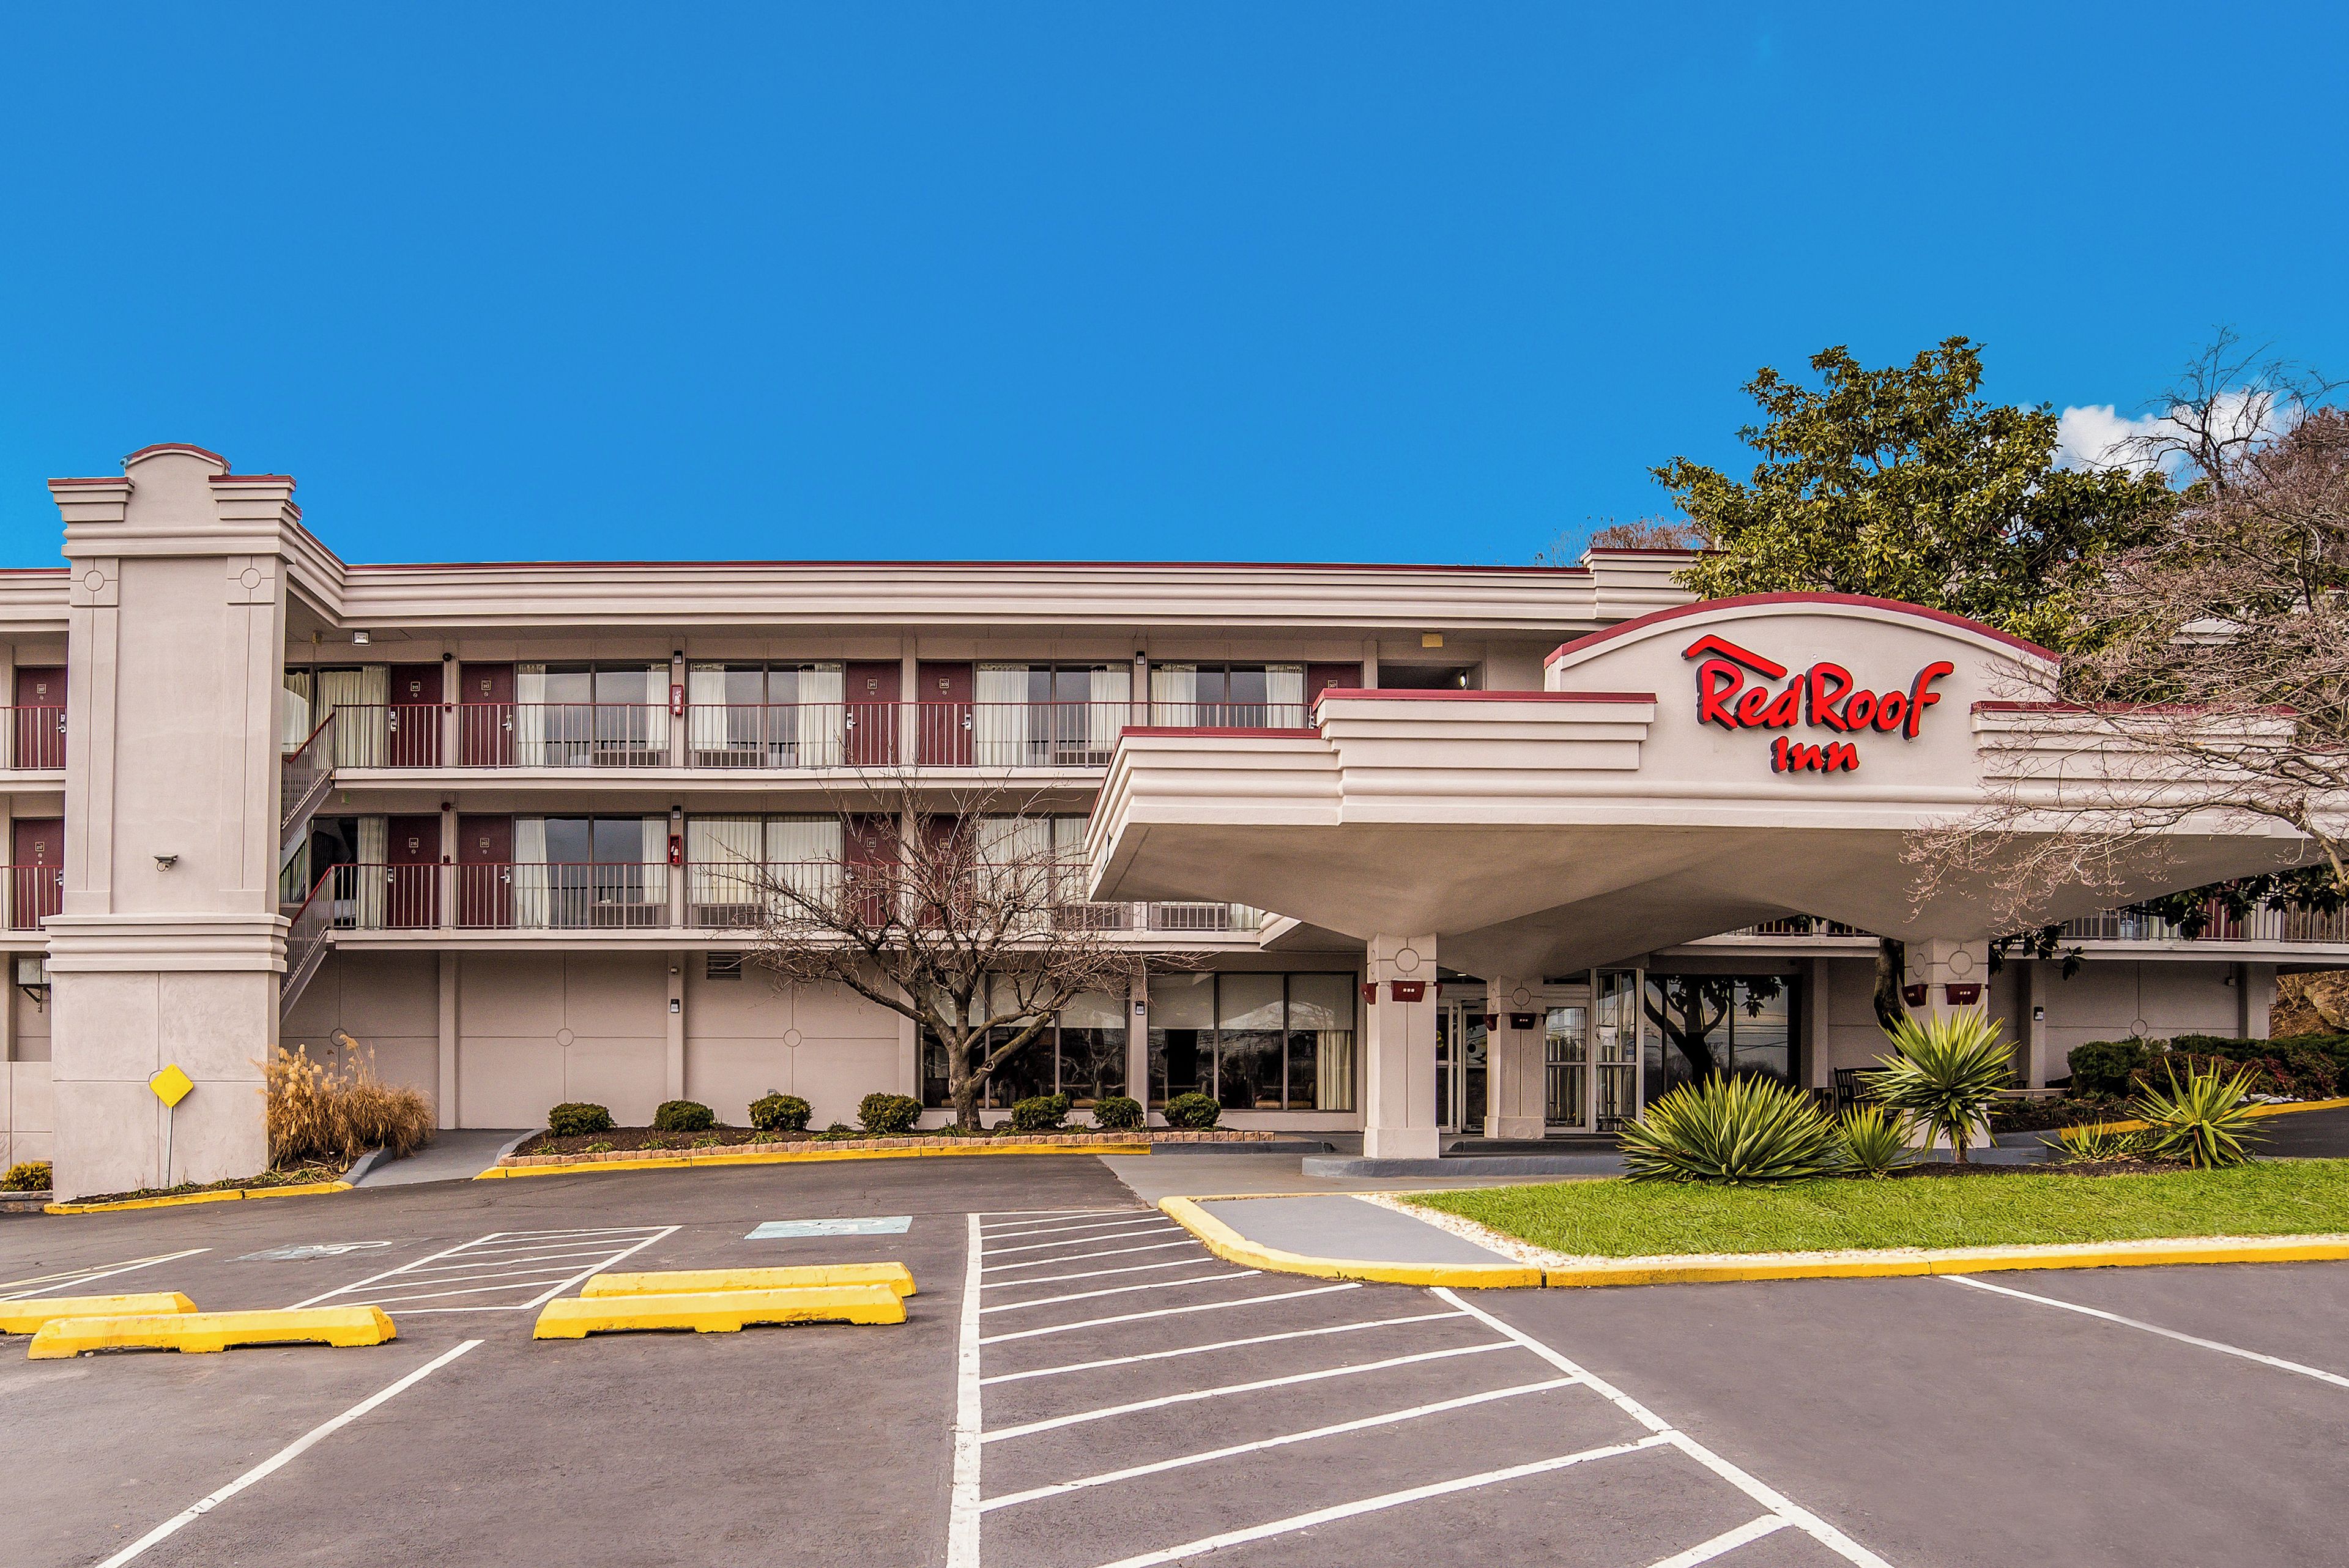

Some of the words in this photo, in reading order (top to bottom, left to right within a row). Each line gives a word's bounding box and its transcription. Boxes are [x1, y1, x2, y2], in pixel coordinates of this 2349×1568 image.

[1697, 659, 1804, 730] Red
[1806, 661, 1954, 740] Roof
[1771, 735, 1860, 773] Inn
